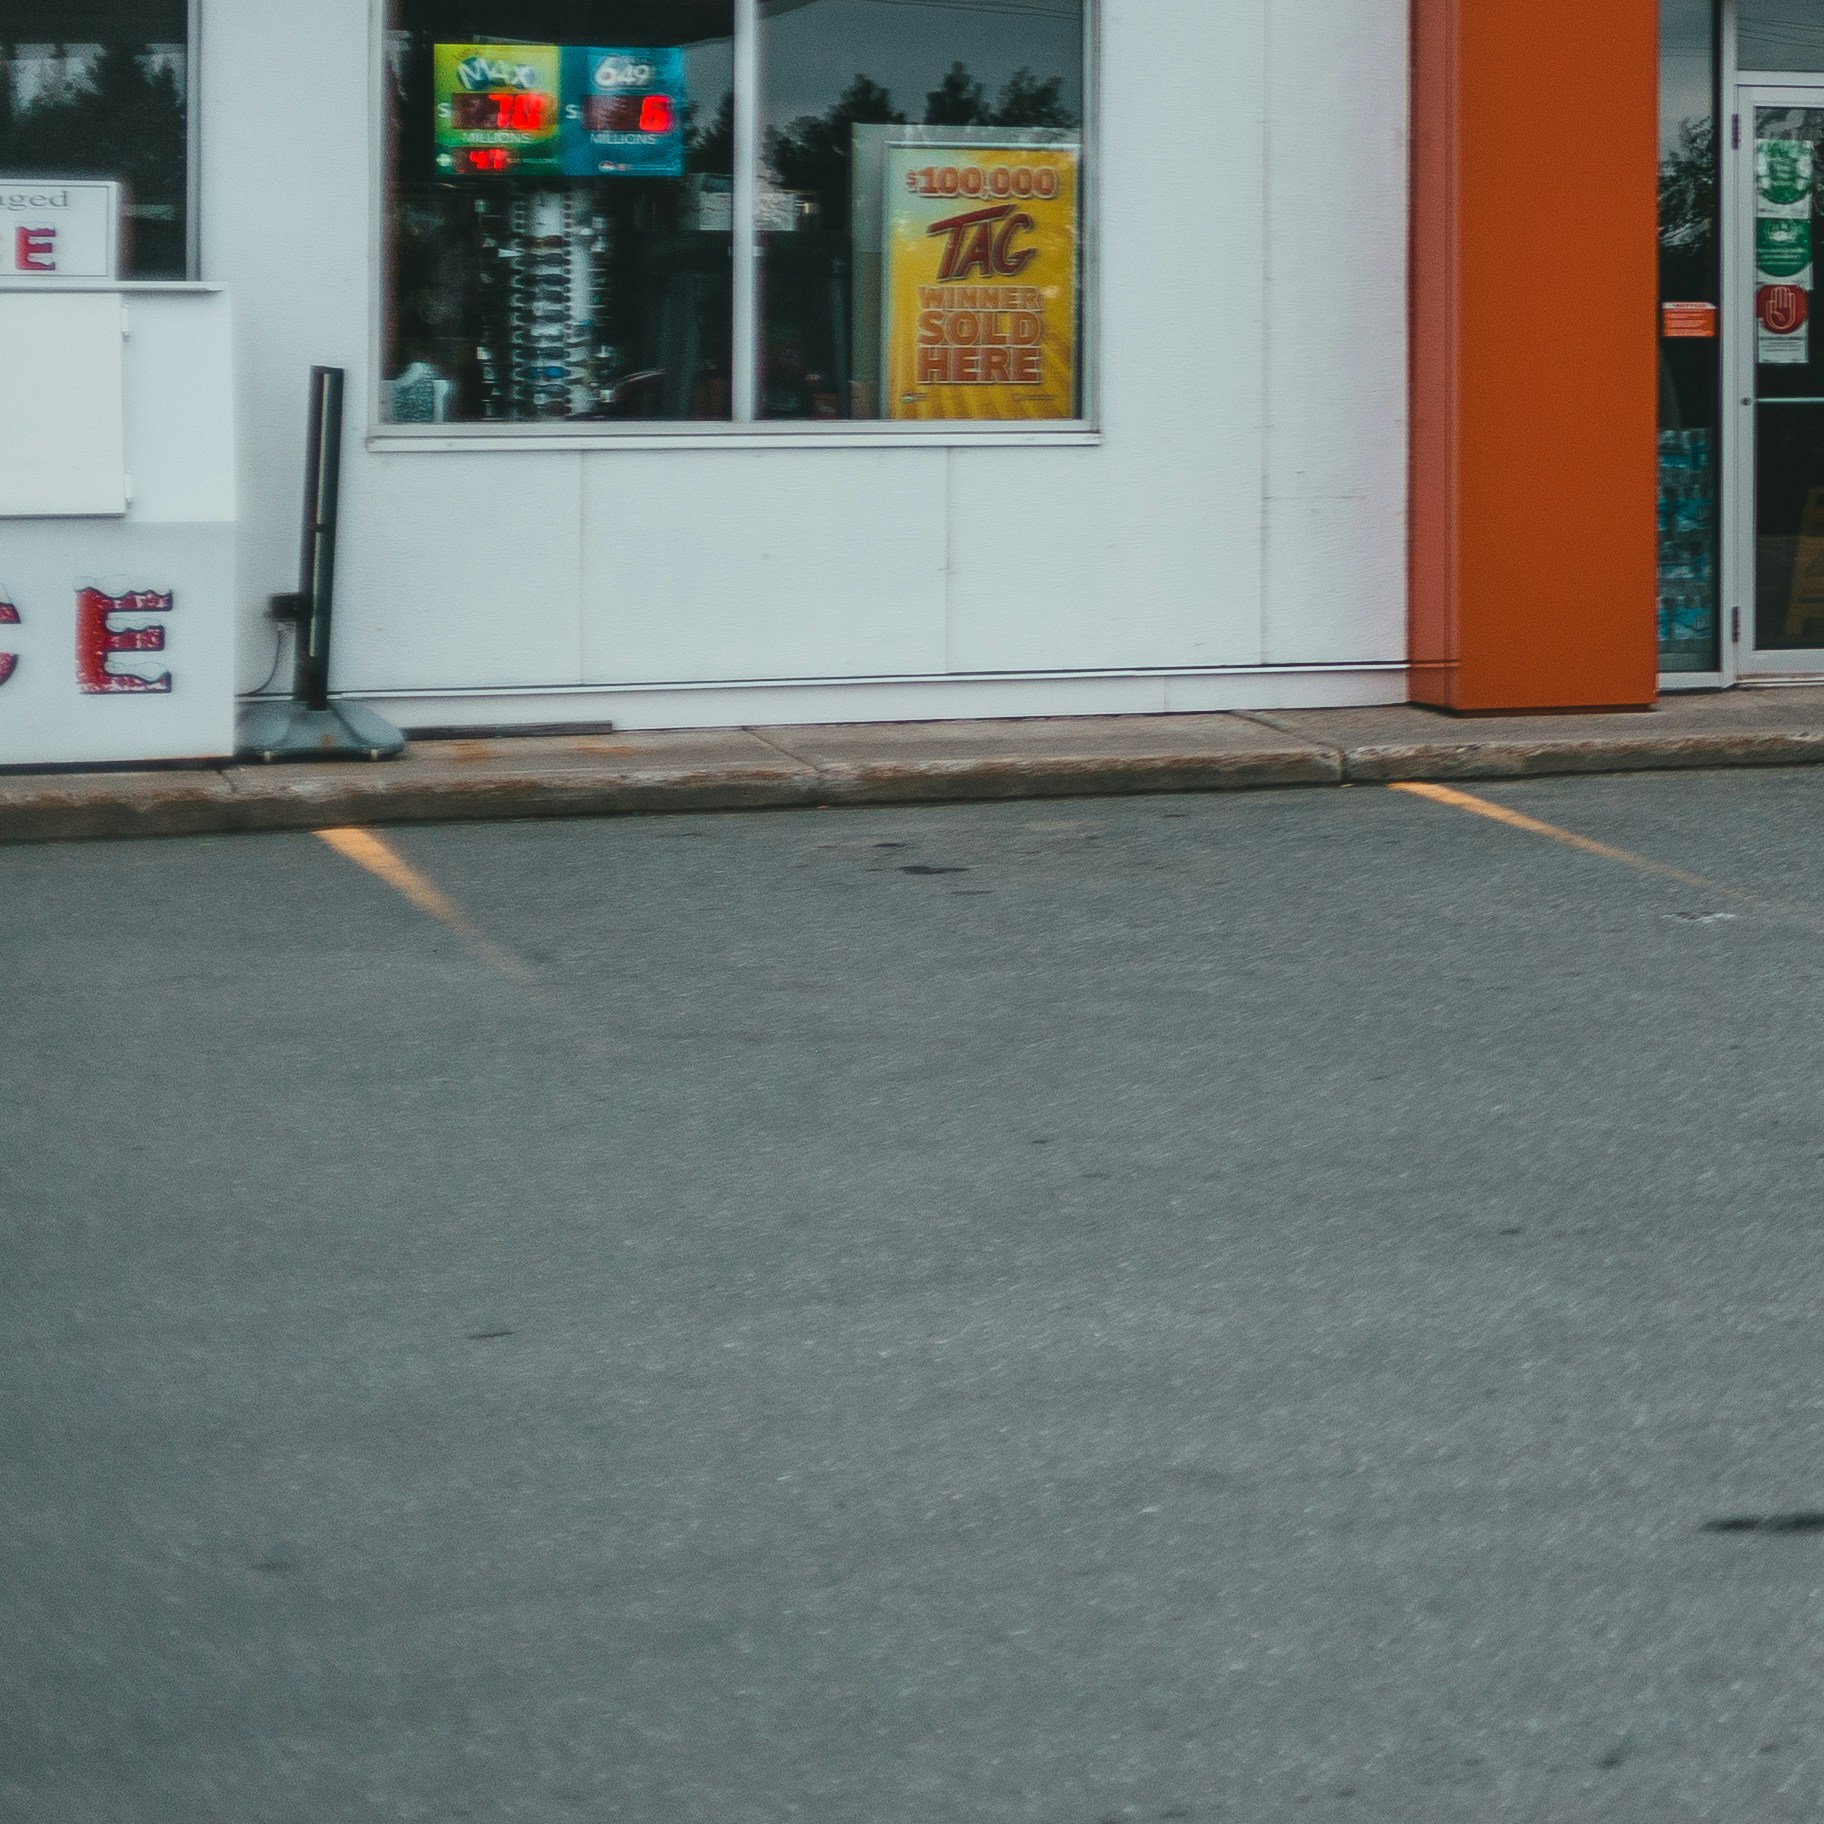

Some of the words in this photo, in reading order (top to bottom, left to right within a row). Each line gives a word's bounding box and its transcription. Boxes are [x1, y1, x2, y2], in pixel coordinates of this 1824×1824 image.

[907, 165, 1059, 199] $100,000
[0, 190, 71, 212] ged
[927, 204, 1036, 282] TAG
[919, 287, 1042, 310] WINNER
[917, 310, 1042, 346] SOLD
[917, 347, 1042, 382] HERE
